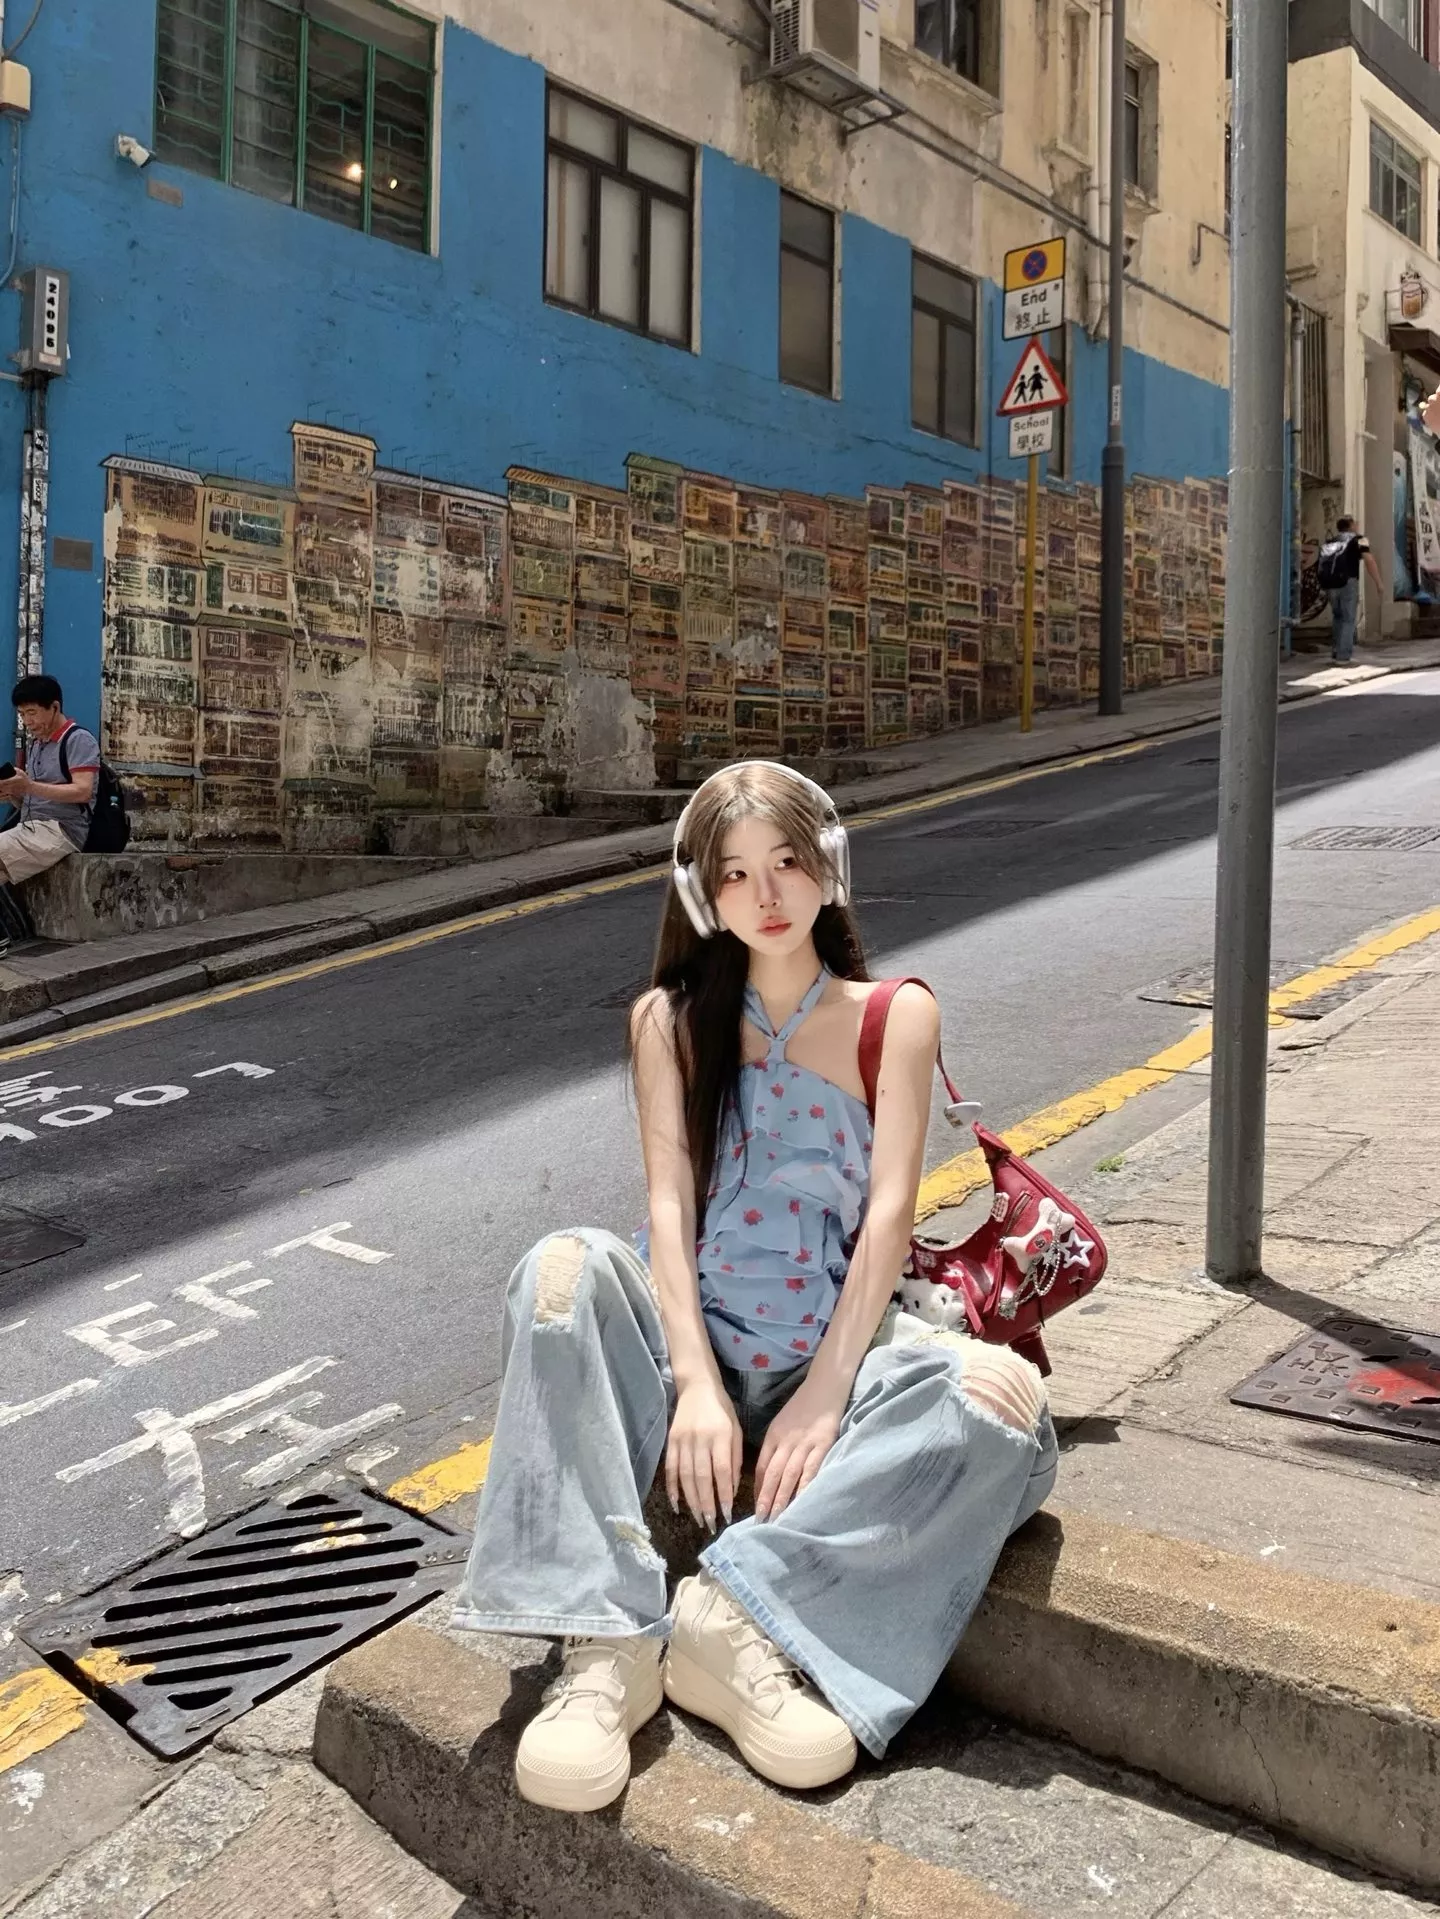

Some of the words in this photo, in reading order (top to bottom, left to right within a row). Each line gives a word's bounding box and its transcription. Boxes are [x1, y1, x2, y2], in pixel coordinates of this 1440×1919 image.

[1021, 288, 1047, 307] End
[1015, 307, 1051, 331] 終止
[1014, 416, 1049, 431] School
